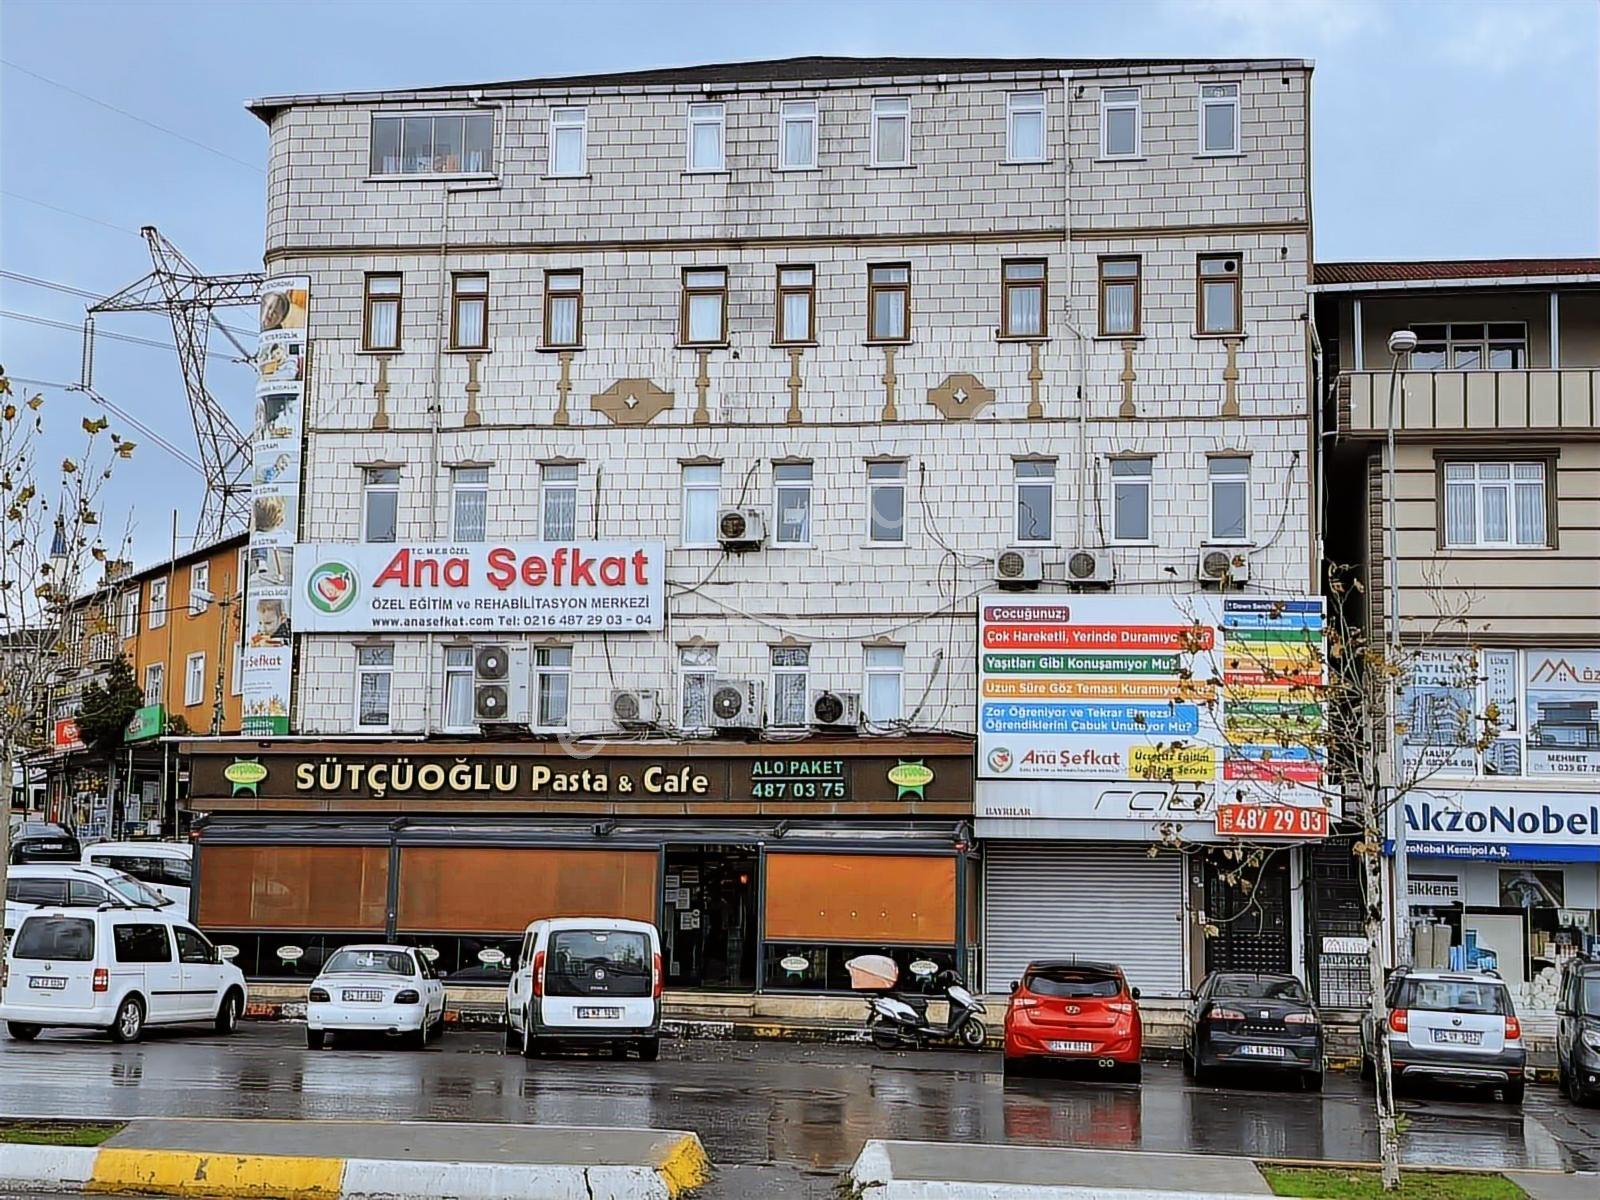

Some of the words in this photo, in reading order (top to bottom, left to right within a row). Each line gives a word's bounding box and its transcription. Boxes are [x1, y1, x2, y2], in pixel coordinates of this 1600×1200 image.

[373, 548, 470, 588] Ana
[487, 547, 649, 591] Şefkat
[372, 597, 405, 610] ÖZEL
[409, 596, 453, 610] EĞİTİM
[456, 600, 471, 610] ve
[474, 595, 587, 609] REHABİLİTASYON
[591, 594, 650, 609] MERKEZİ
[372, 616, 494, 627] www.anasefkat.com
[498, 615, 520, 626] Tel:
[523, 615, 556, 626] 0216
[559, 615, 583, 625] 487
[587, 615, 602, 625] 29
[606, 615, 623, 625] 03
[635, 614, 652, 625] 04
[992, 608, 1067, 621] Çocuğunuz;
[986, 631, 1009, 643] Çok
[1013, 631, 1070, 644] Hareketli,
[1073, 631, 1117, 643] Yerinde
[1121, 632, 1179, 645] Duramıyo
[987, 658, 1036, 671] Yaşıtları
[1039, 658, 1064, 670] Gibi
[1068, 658, 1148, 672] Konuşamıyor
[1152, 659, 1177, 671] Mu?
[986, 682, 1018, 693] Uzun
[1019, 682, 1046, 693] Süre
[1050, 681, 1072, 693] Göz
[1077, 682, 1117, 693] Teması
[986, 707, 1006, 718] Zor
[1009, 706, 1067, 720] Öğreniyor
[1071, 709, 1084, 718] ve
[1088, 708, 1122, 718] Tekrar
[986, 719, 1068, 732] Öğrendiklerini
[1071, 720, 1107, 732] Çabuk
[1168, 721, 1192, 732] Mu?
[1020, 750, 1057, 765] Ana
[1060, 749, 1121, 768] Şefkat
[1547, 753, 1588, 763] MEHMET
[752, 761, 785, 775] ALO
[790, 761, 844, 775] PAKET
[296, 757, 518, 798] SÜTÇÜOĞLU
[531, 765, 609, 793] Pasta
[618, 776, 633, 792] &
[644, 766, 709, 793] Cafe
[752, 783, 785, 798] 487
[793, 783, 816, 798] 03
[822, 783, 845, 798] 75
[1235, 808, 1267, 830] 487
[1273, 809, 1295, 831] 29
[1300, 810, 1321, 831] 03
[1446, 844, 1488, 857] Kemipol
[1408, 882, 1459, 897] sikkens
